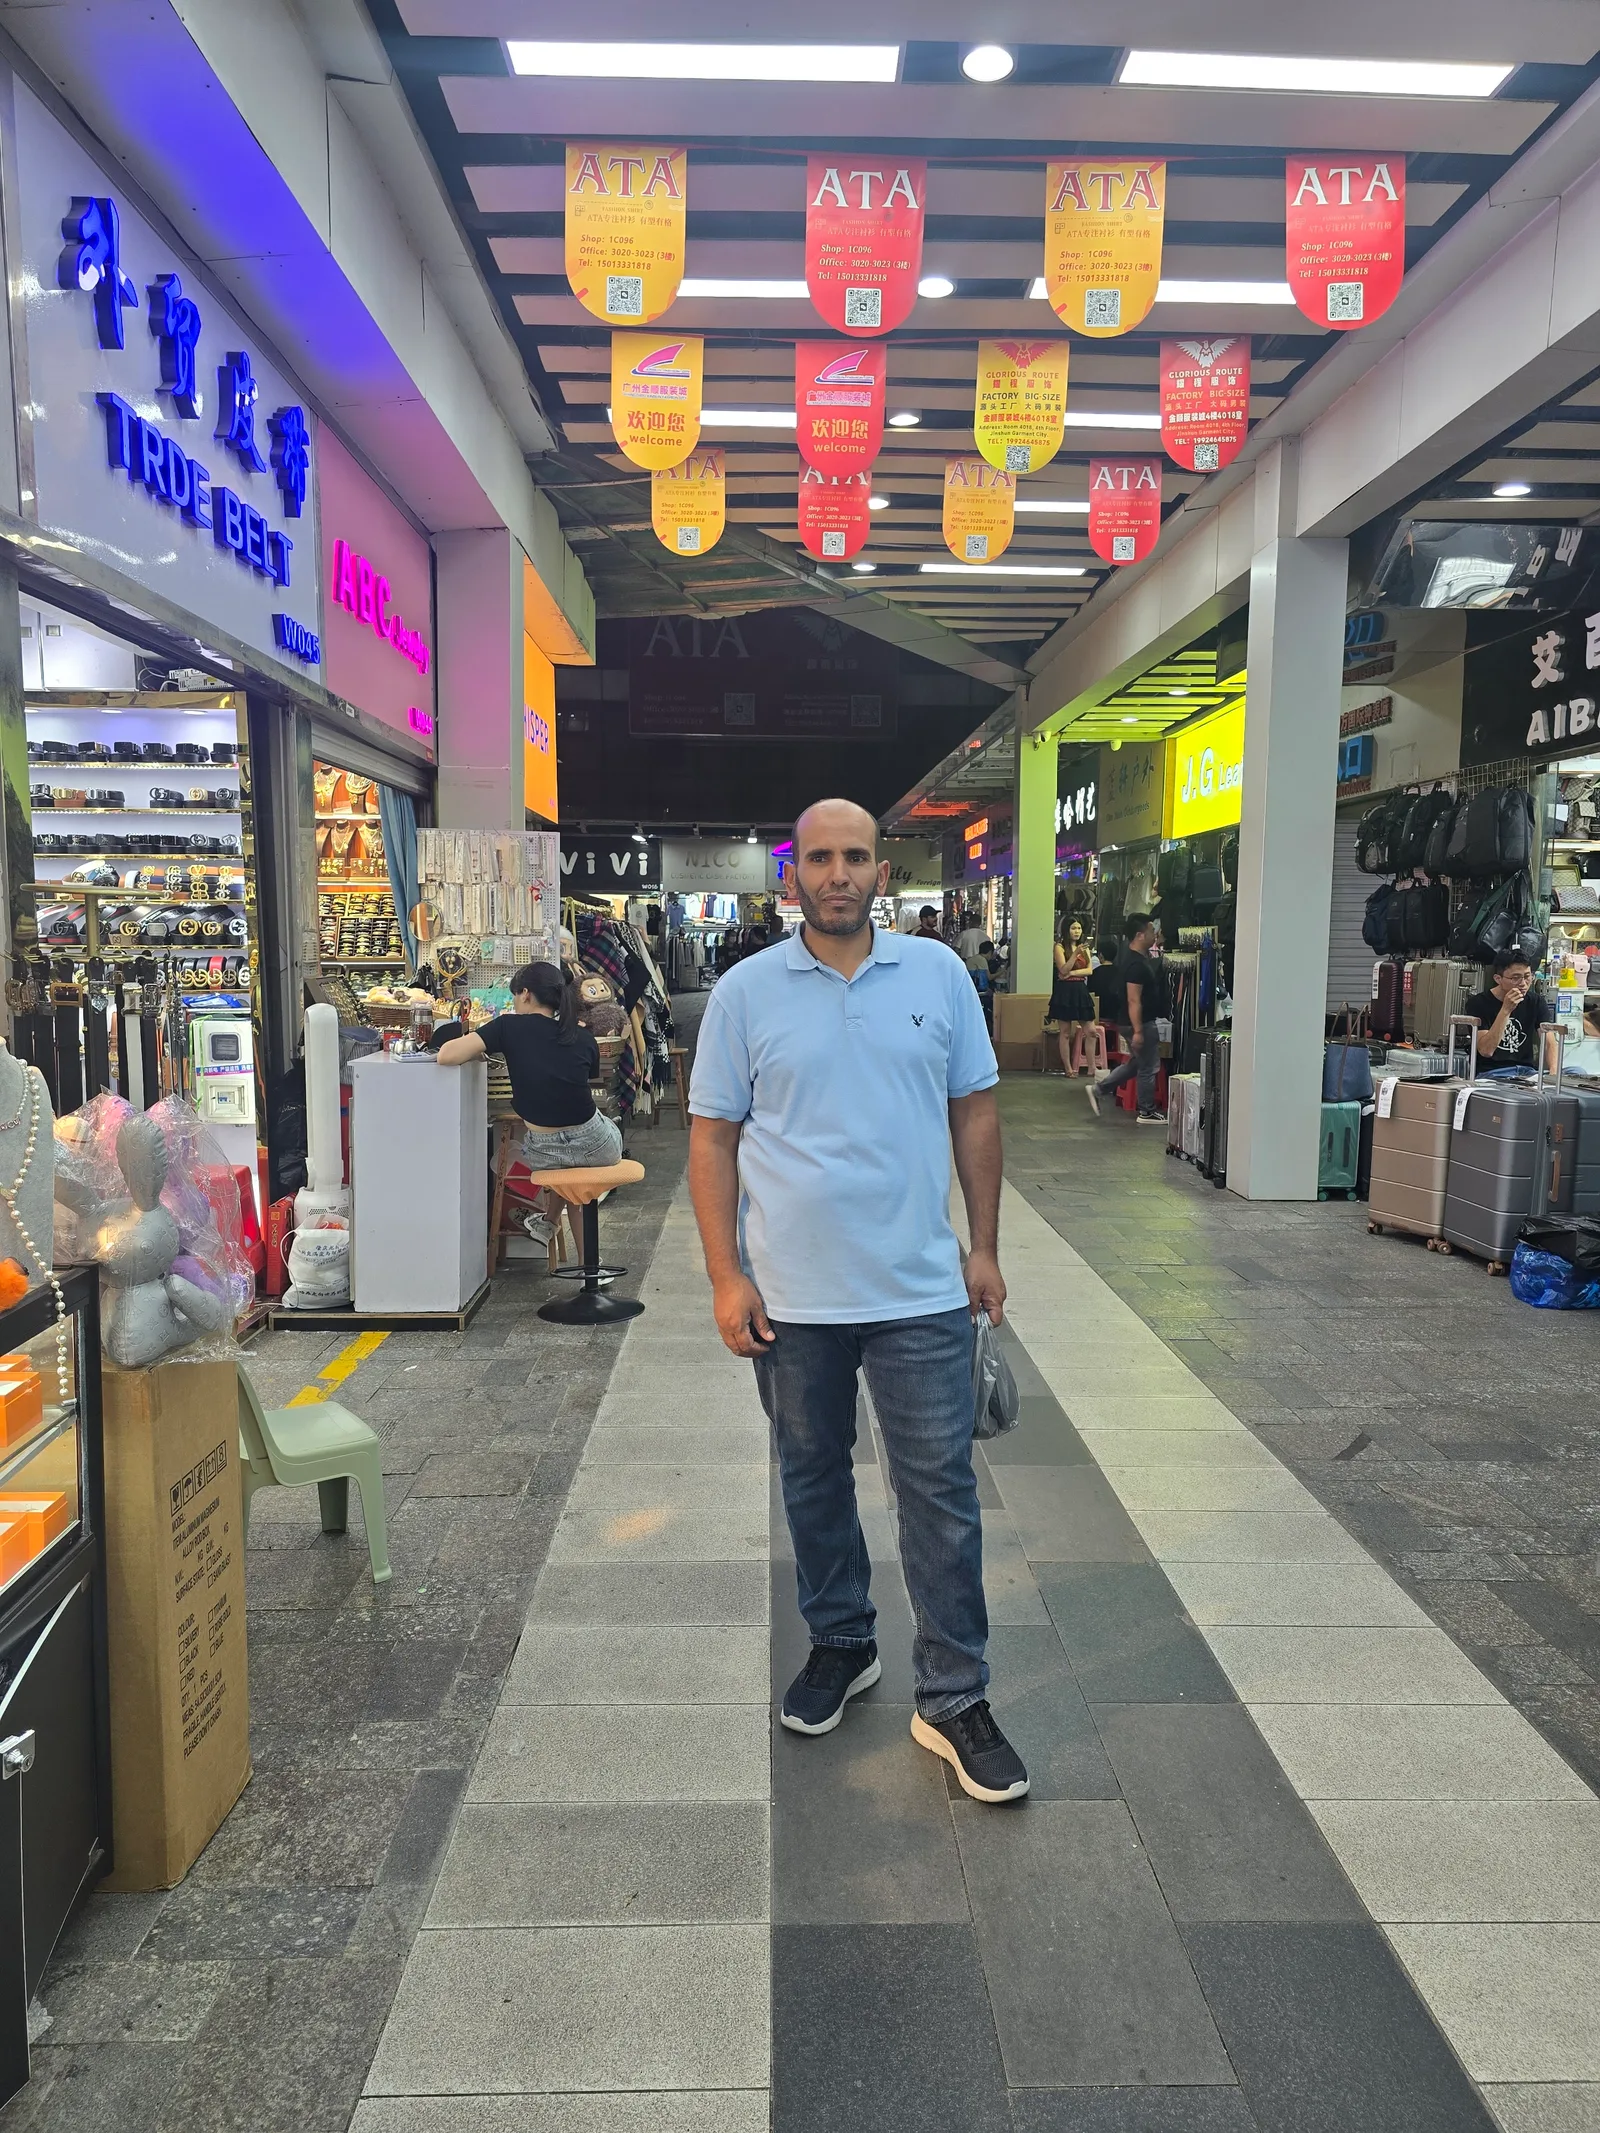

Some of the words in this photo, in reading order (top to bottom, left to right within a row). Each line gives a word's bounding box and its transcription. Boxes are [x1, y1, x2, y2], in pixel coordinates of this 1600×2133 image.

[569, 153, 682, 199] ATA
[811, 167, 920, 210] ATA
[1049, 169, 1161, 212] ATA
[1291, 163, 1400, 207] ATA
[581, 234, 605, 244] Shop:
[609, 236, 634, 244] 1C096
[580, 246, 607, 255] Office:
[611, 248, 654, 258] 3020-3023
[821, 244, 844, 254] Shop:
[848, 245, 872, 254] 1C096
[1301, 243, 1325, 252] Shop:
[1329, 241, 1353, 249] 1C096
[1060, 251, 1084, 260] Shop:
[1088, 250, 1113, 258] 1C096
[1300, 256, 1328, 265] Office:
[1332, 253, 1372, 262] 3020-3023
[578, 259, 593, 267] Tel:
[597, 260, 651, 270] 15013331818
[819, 258, 847, 266] Office:
[851, 260, 891, 268] 3020-3023
[1059, 263, 1087, 271] Office:
[1090, 262, 1133, 270] 3020-3023
[818, 272, 833, 280] Tel:
[837, 272, 888, 281] 15013331818
[1299, 270, 1314, 278] Tel:
[1318, 267, 1369, 276] 15013331818
[986, 371, 1027, 379] GLORIOUS
[1032, 371, 1059, 379] ROUTE
[1169, 369, 1211, 379] GLORIOUS
[1216, 367, 1243, 376] ROUTE
[982, 392, 1019, 400] FACTORY
[1025, 393, 1061, 401] BIG-SIZE
[1166, 391, 1204, 401] FACTORY
[1209, 389, 1245, 398] BIG-SIZE
[980, 402, 1018, 411] 源头工厂
[1165, 401, 1202, 412] 源头工厂
[627, 410, 685, 432] 欢迎您
[811, 418, 869, 440] 欢迎您
[629, 434, 683, 446] welcome
[1006, 438, 1051, 446] 19924645875
[1193, 436, 1237, 444] 19924645875
[813, 441, 866, 454] welcome
[947, 461, 1014, 488] ATA
[1092, 466, 1158, 491] ATA
[95, 392, 212, 529] TRDE
[211, 487, 293, 587] BELT
[332, 538, 392, 640] ABC
[271, 613, 320, 664] W045
[638, 616, 751, 658] ATA
[1181, 747, 1214, 803] J.G
[1218, 756, 1244, 791] Lea
[685, 850, 741, 868] NICO
[725, 873, 756, 881] FACTORY
[172, 1510, 186, 1533] MODEL:
[175, 1575, 193, 1604] SURFACE
[184, 1623, 199, 1650] SILVERY
[185, 1641, 198, 1668] BLACK
[186, 1664, 194, 1685] RED
[215, 1630, 224, 1650] BLUE
[183, 1731, 200, 1762] PLEASE
